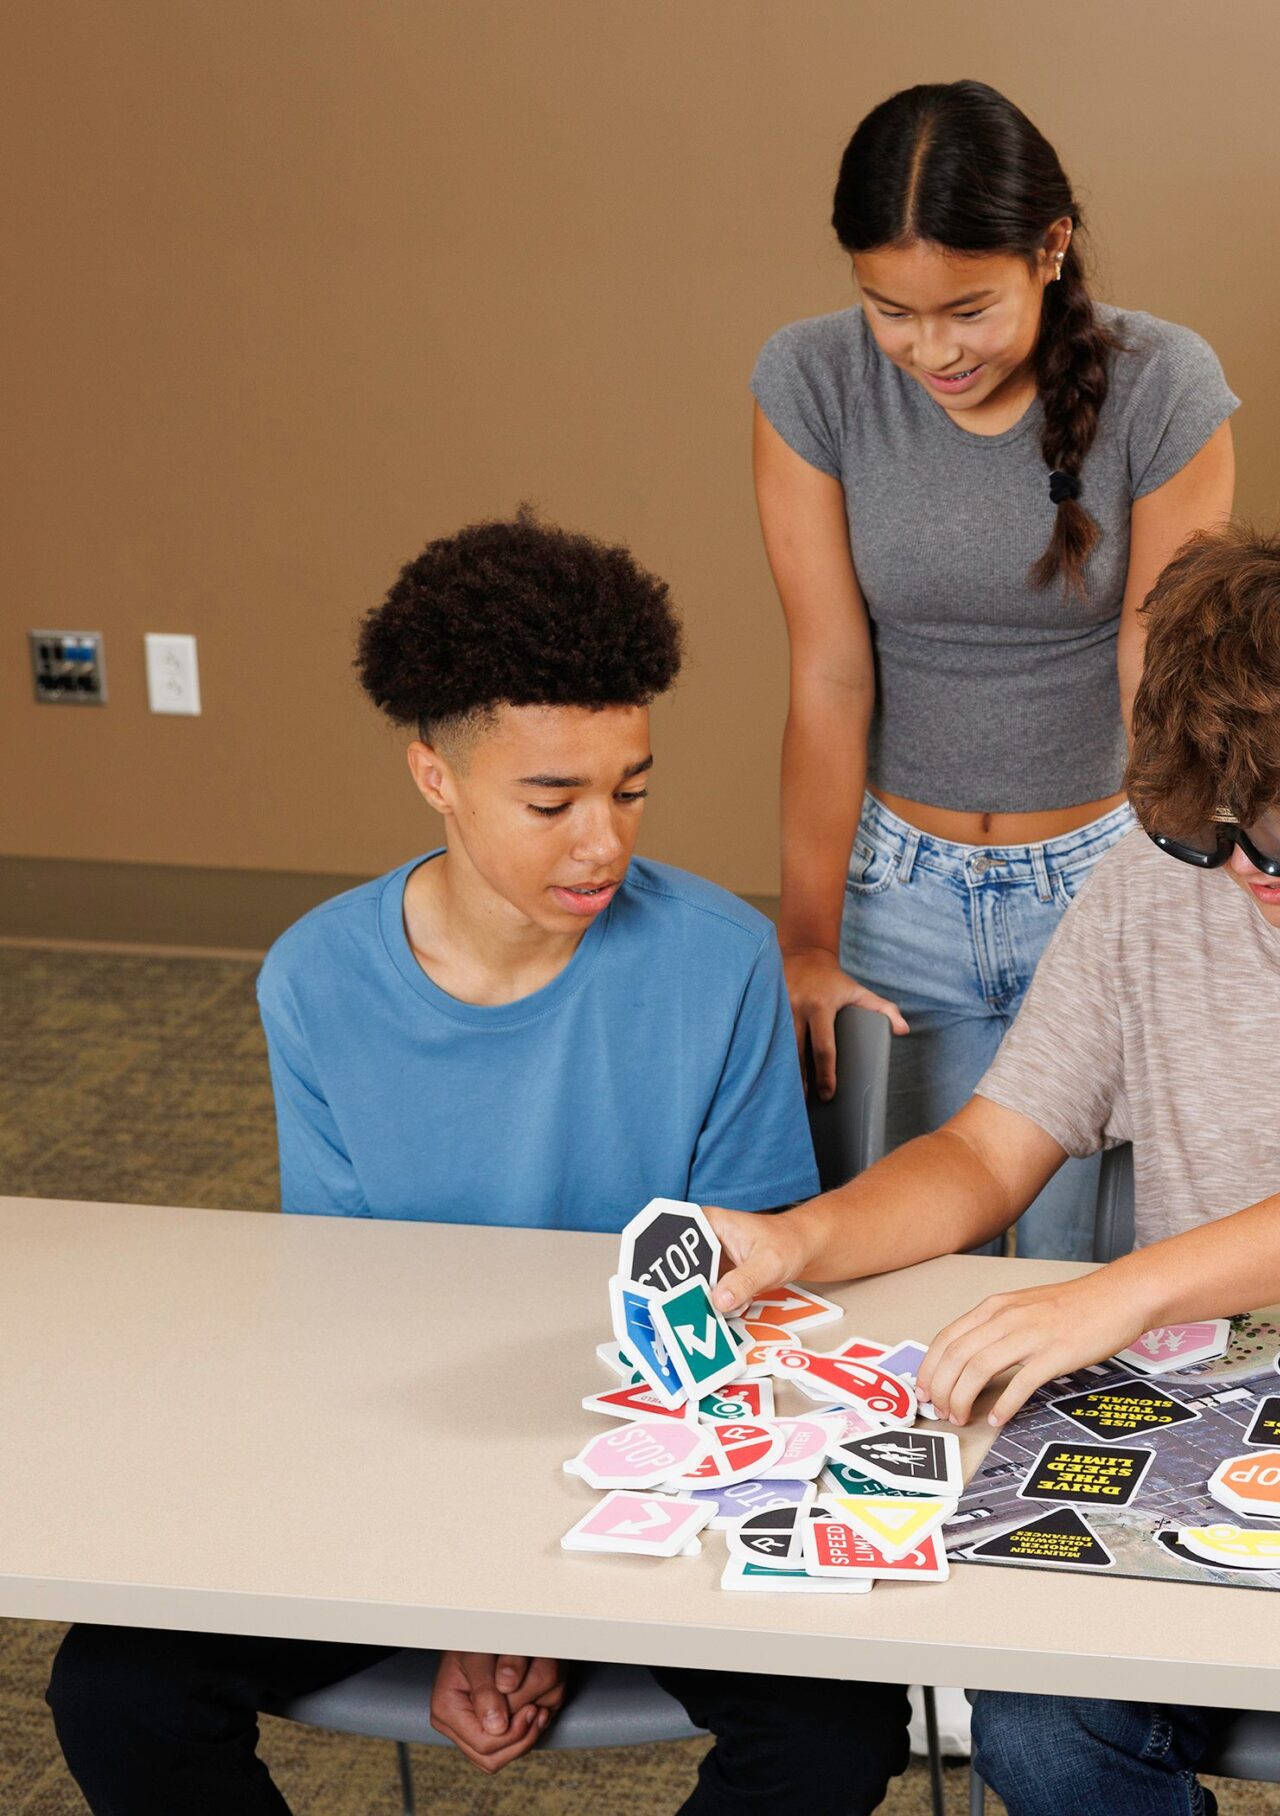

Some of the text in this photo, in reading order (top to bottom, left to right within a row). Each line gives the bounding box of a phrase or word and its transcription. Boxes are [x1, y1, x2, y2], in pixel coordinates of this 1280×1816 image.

[1087, 1394, 1174, 1408] SIGNALS
[1072, 1408, 1173, 1423] CORRECT
[1098, 1403, 1154, 1414] TURN
[1099, 1418, 1137, 1428] USE
[722, 1427, 755, 1440] R
[607, 1428, 676, 1468] STOP
[784, 1431, 814, 1458] ENTER
[1054, 1453, 1134, 1467] LIMIT
[1047, 1462, 1134, 1477] SPEED
[1057, 1473, 1110, 1484] THE
[1037, 1480, 1122, 1495] DRIVE
[1010, 1535, 1093, 1548] FOLLOWING
[1015, 1530, 1093, 1542] DISTANCES
[750, 1537, 785, 1552] R
[826, 1525, 849, 1565] SPEED
[1020, 1542, 1079, 1552] PROPER
[1010, 1546, 1081, 1558] MAINTAIN
